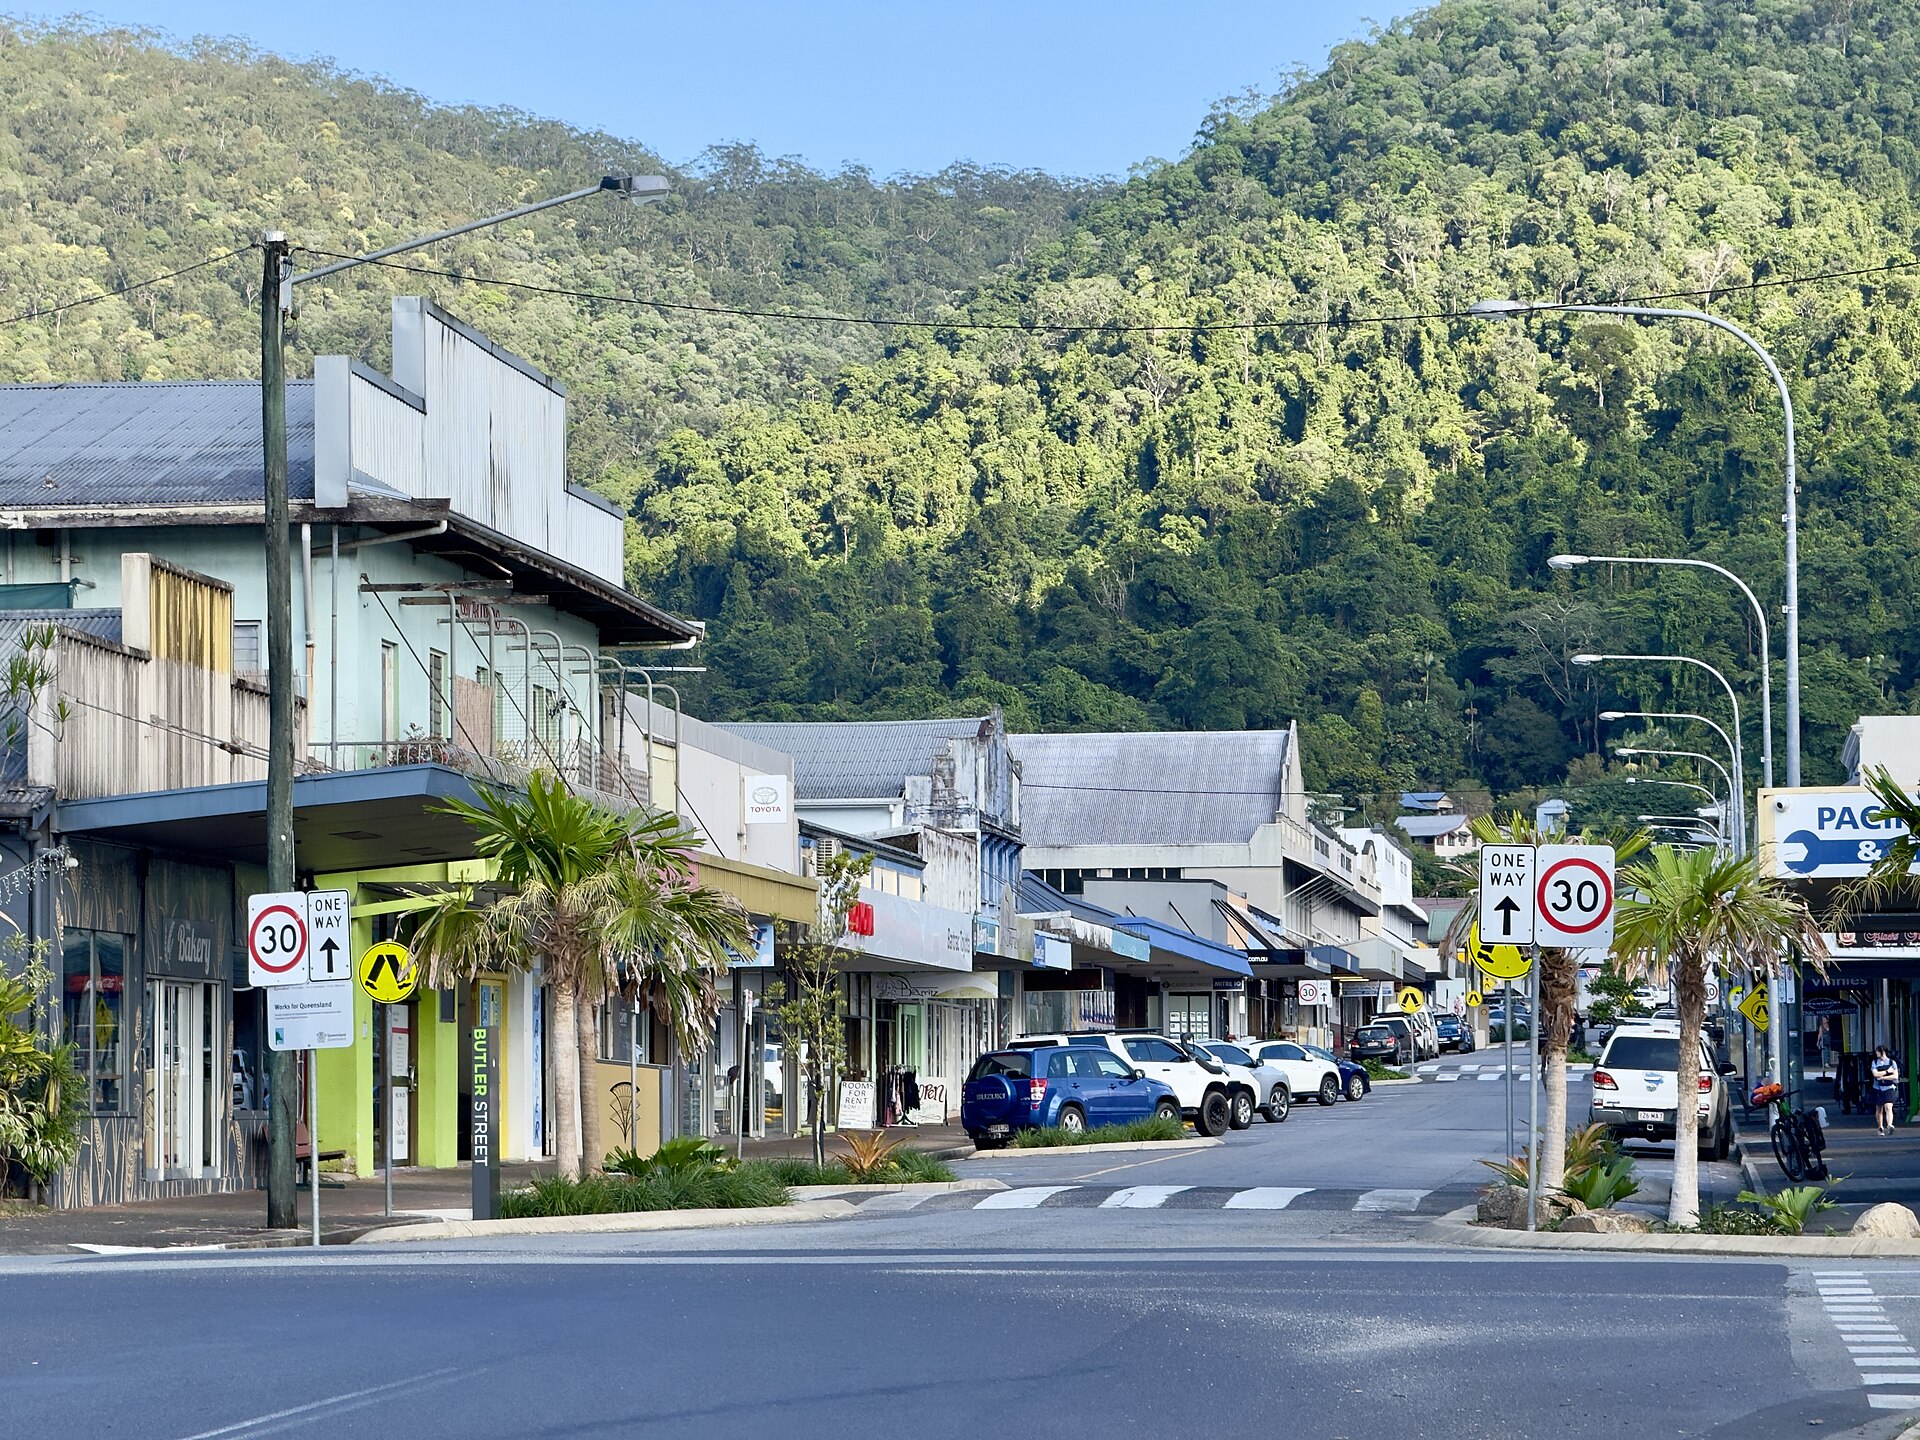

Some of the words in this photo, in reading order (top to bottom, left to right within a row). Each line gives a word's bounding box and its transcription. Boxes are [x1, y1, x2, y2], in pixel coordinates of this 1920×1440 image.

[1857, 840, 1882, 862] &
[1491, 854, 1525, 867] ONE
[1490, 872, 1526, 886] WAY
[315, 898, 341, 912] ONE
[1551, 880, 1599, 913] 30
[314, 915, 342, 929] WAY
[261, 924, 297, 954] 30
[177, 925, 211, 974] Bakery
[1303, 987, 1314, 997] 30
[299, 1001, 333, 1010] Queensland
[473, 1028, 488, 1096] BUTLER
[474, 1101, 488, 1167] STREET
